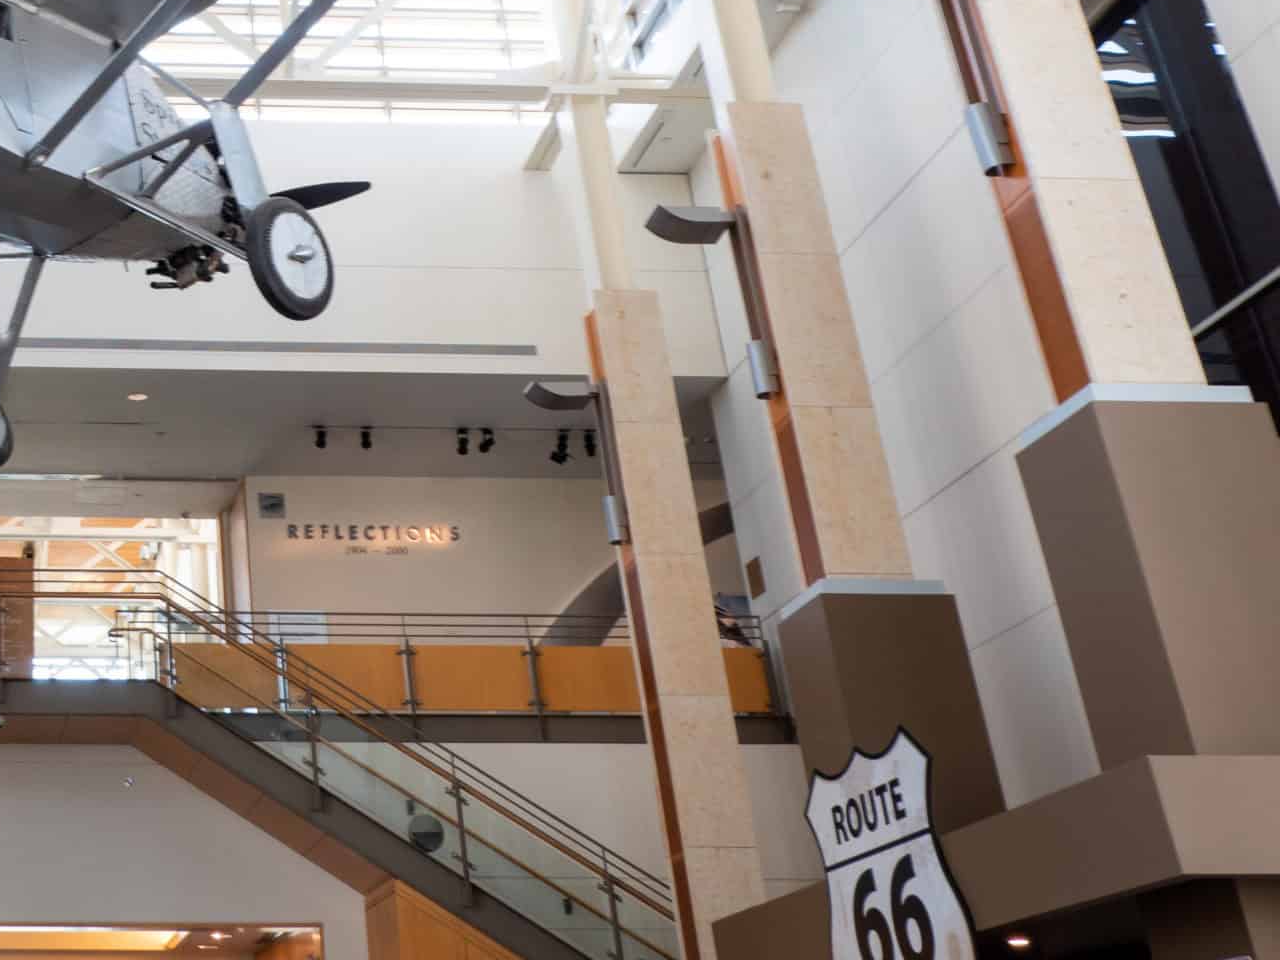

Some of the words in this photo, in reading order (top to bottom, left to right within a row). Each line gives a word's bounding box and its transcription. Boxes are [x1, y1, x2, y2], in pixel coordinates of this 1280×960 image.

[287, 523, 462, 544] REFLECTIONS
[831, 777, 907, 846] ROUTE
[853, 853, 935, 960] 66
